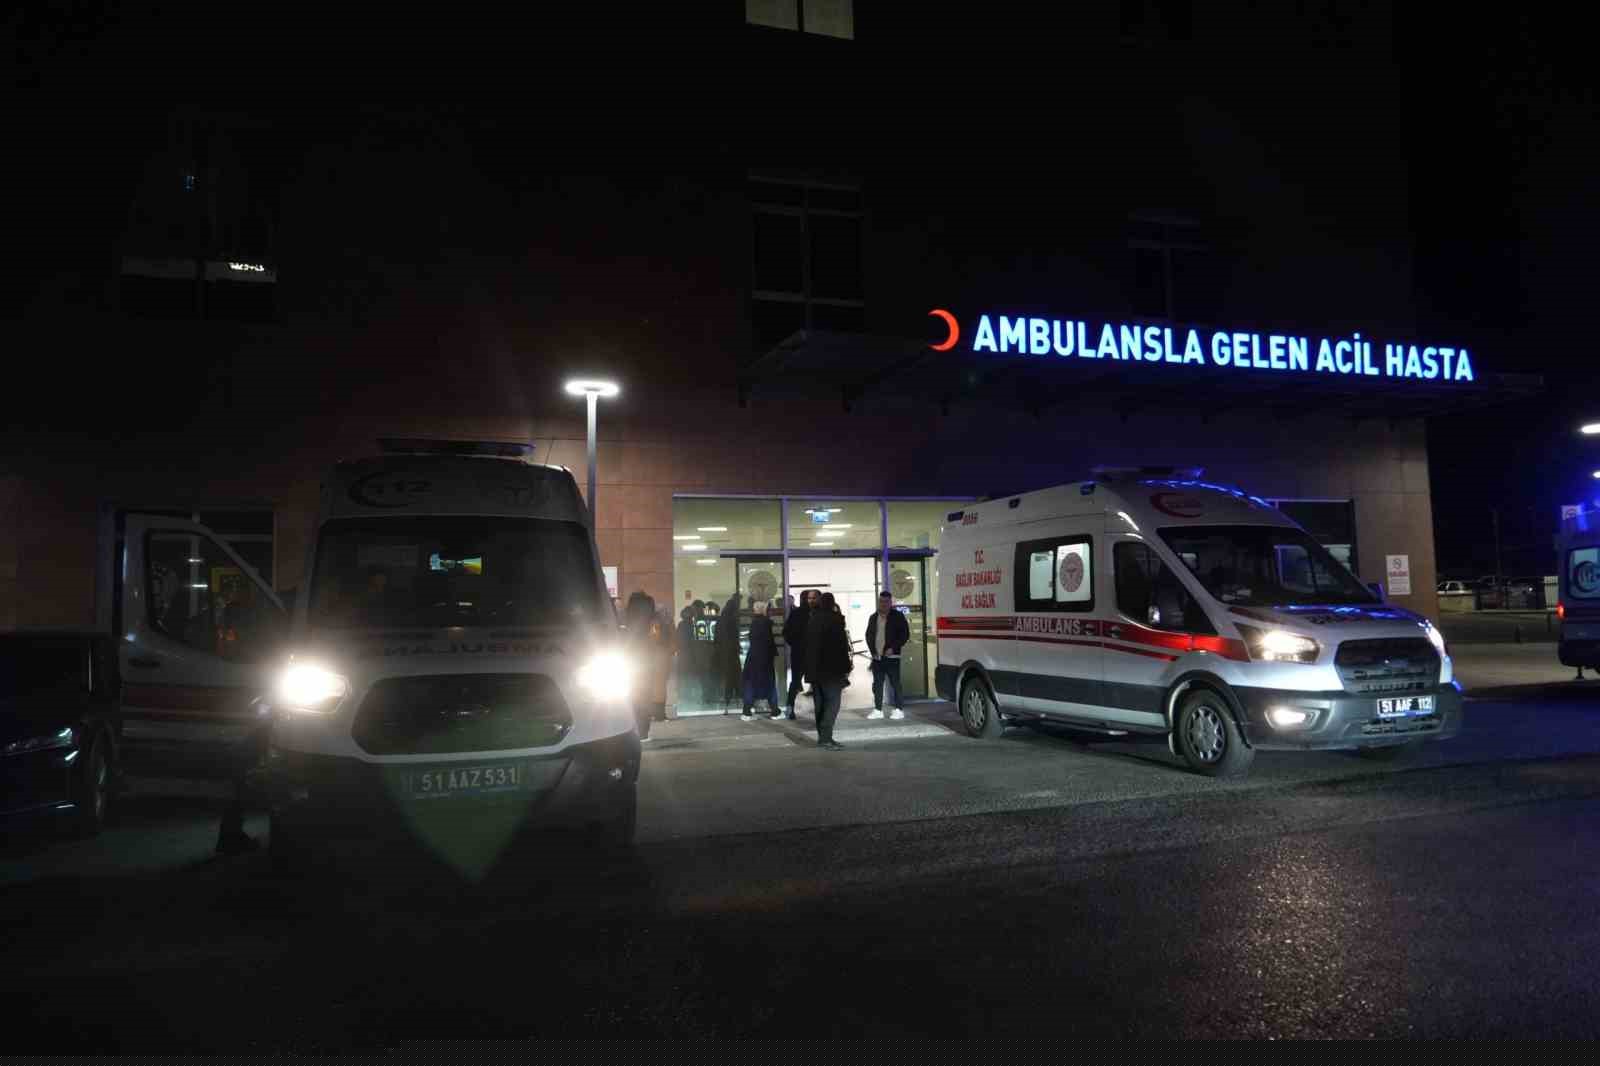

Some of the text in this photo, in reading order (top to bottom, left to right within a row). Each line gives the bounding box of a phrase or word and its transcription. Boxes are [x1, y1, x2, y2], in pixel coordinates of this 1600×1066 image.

[974, 314, 1473, 381] AMBULANSLA GELEN ACİL HASTA
[1015, 617, 1081, 635] AMBULANS
[421, 767, 517, 792] 51 AAZ 531
